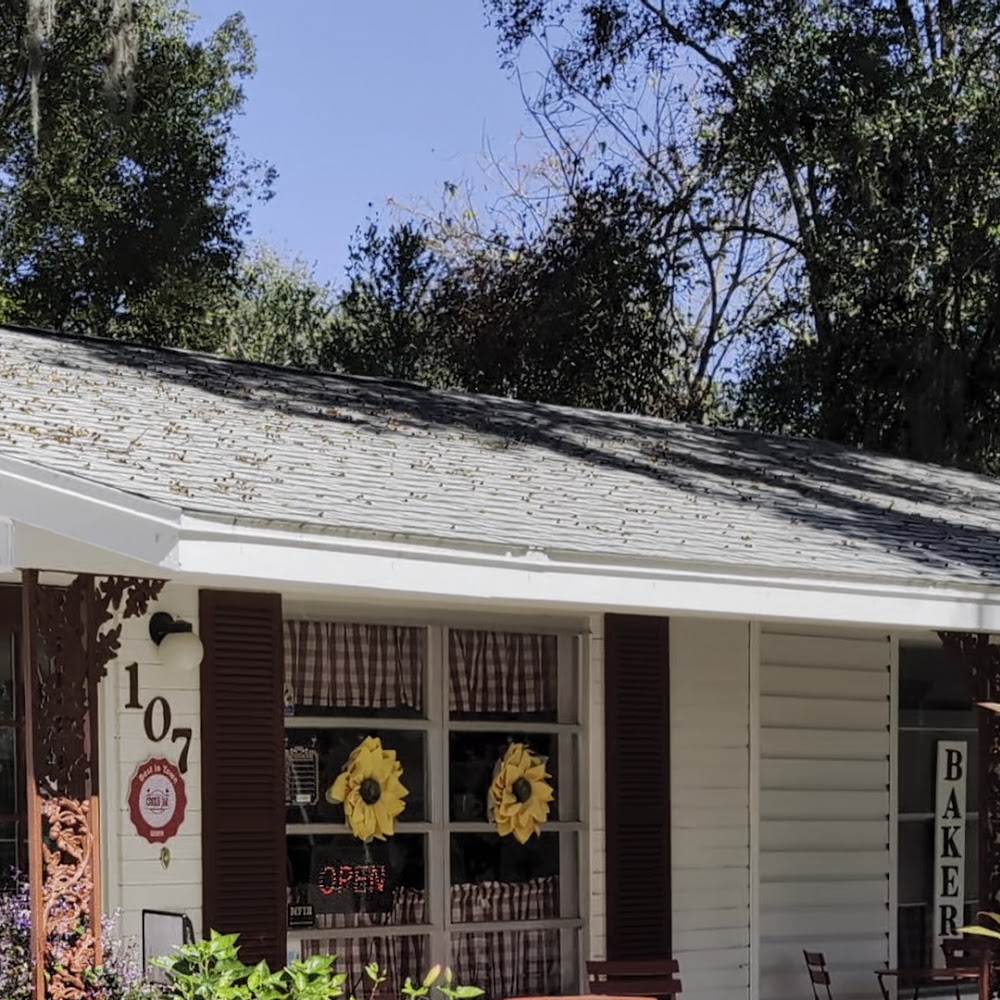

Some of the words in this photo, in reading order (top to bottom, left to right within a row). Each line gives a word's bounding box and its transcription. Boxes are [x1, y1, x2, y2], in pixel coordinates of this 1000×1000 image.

[125, 662, 192, 774] 107
[319, 865, 386, 895] OPEN
[938, 748, 963, 937] BAKER
